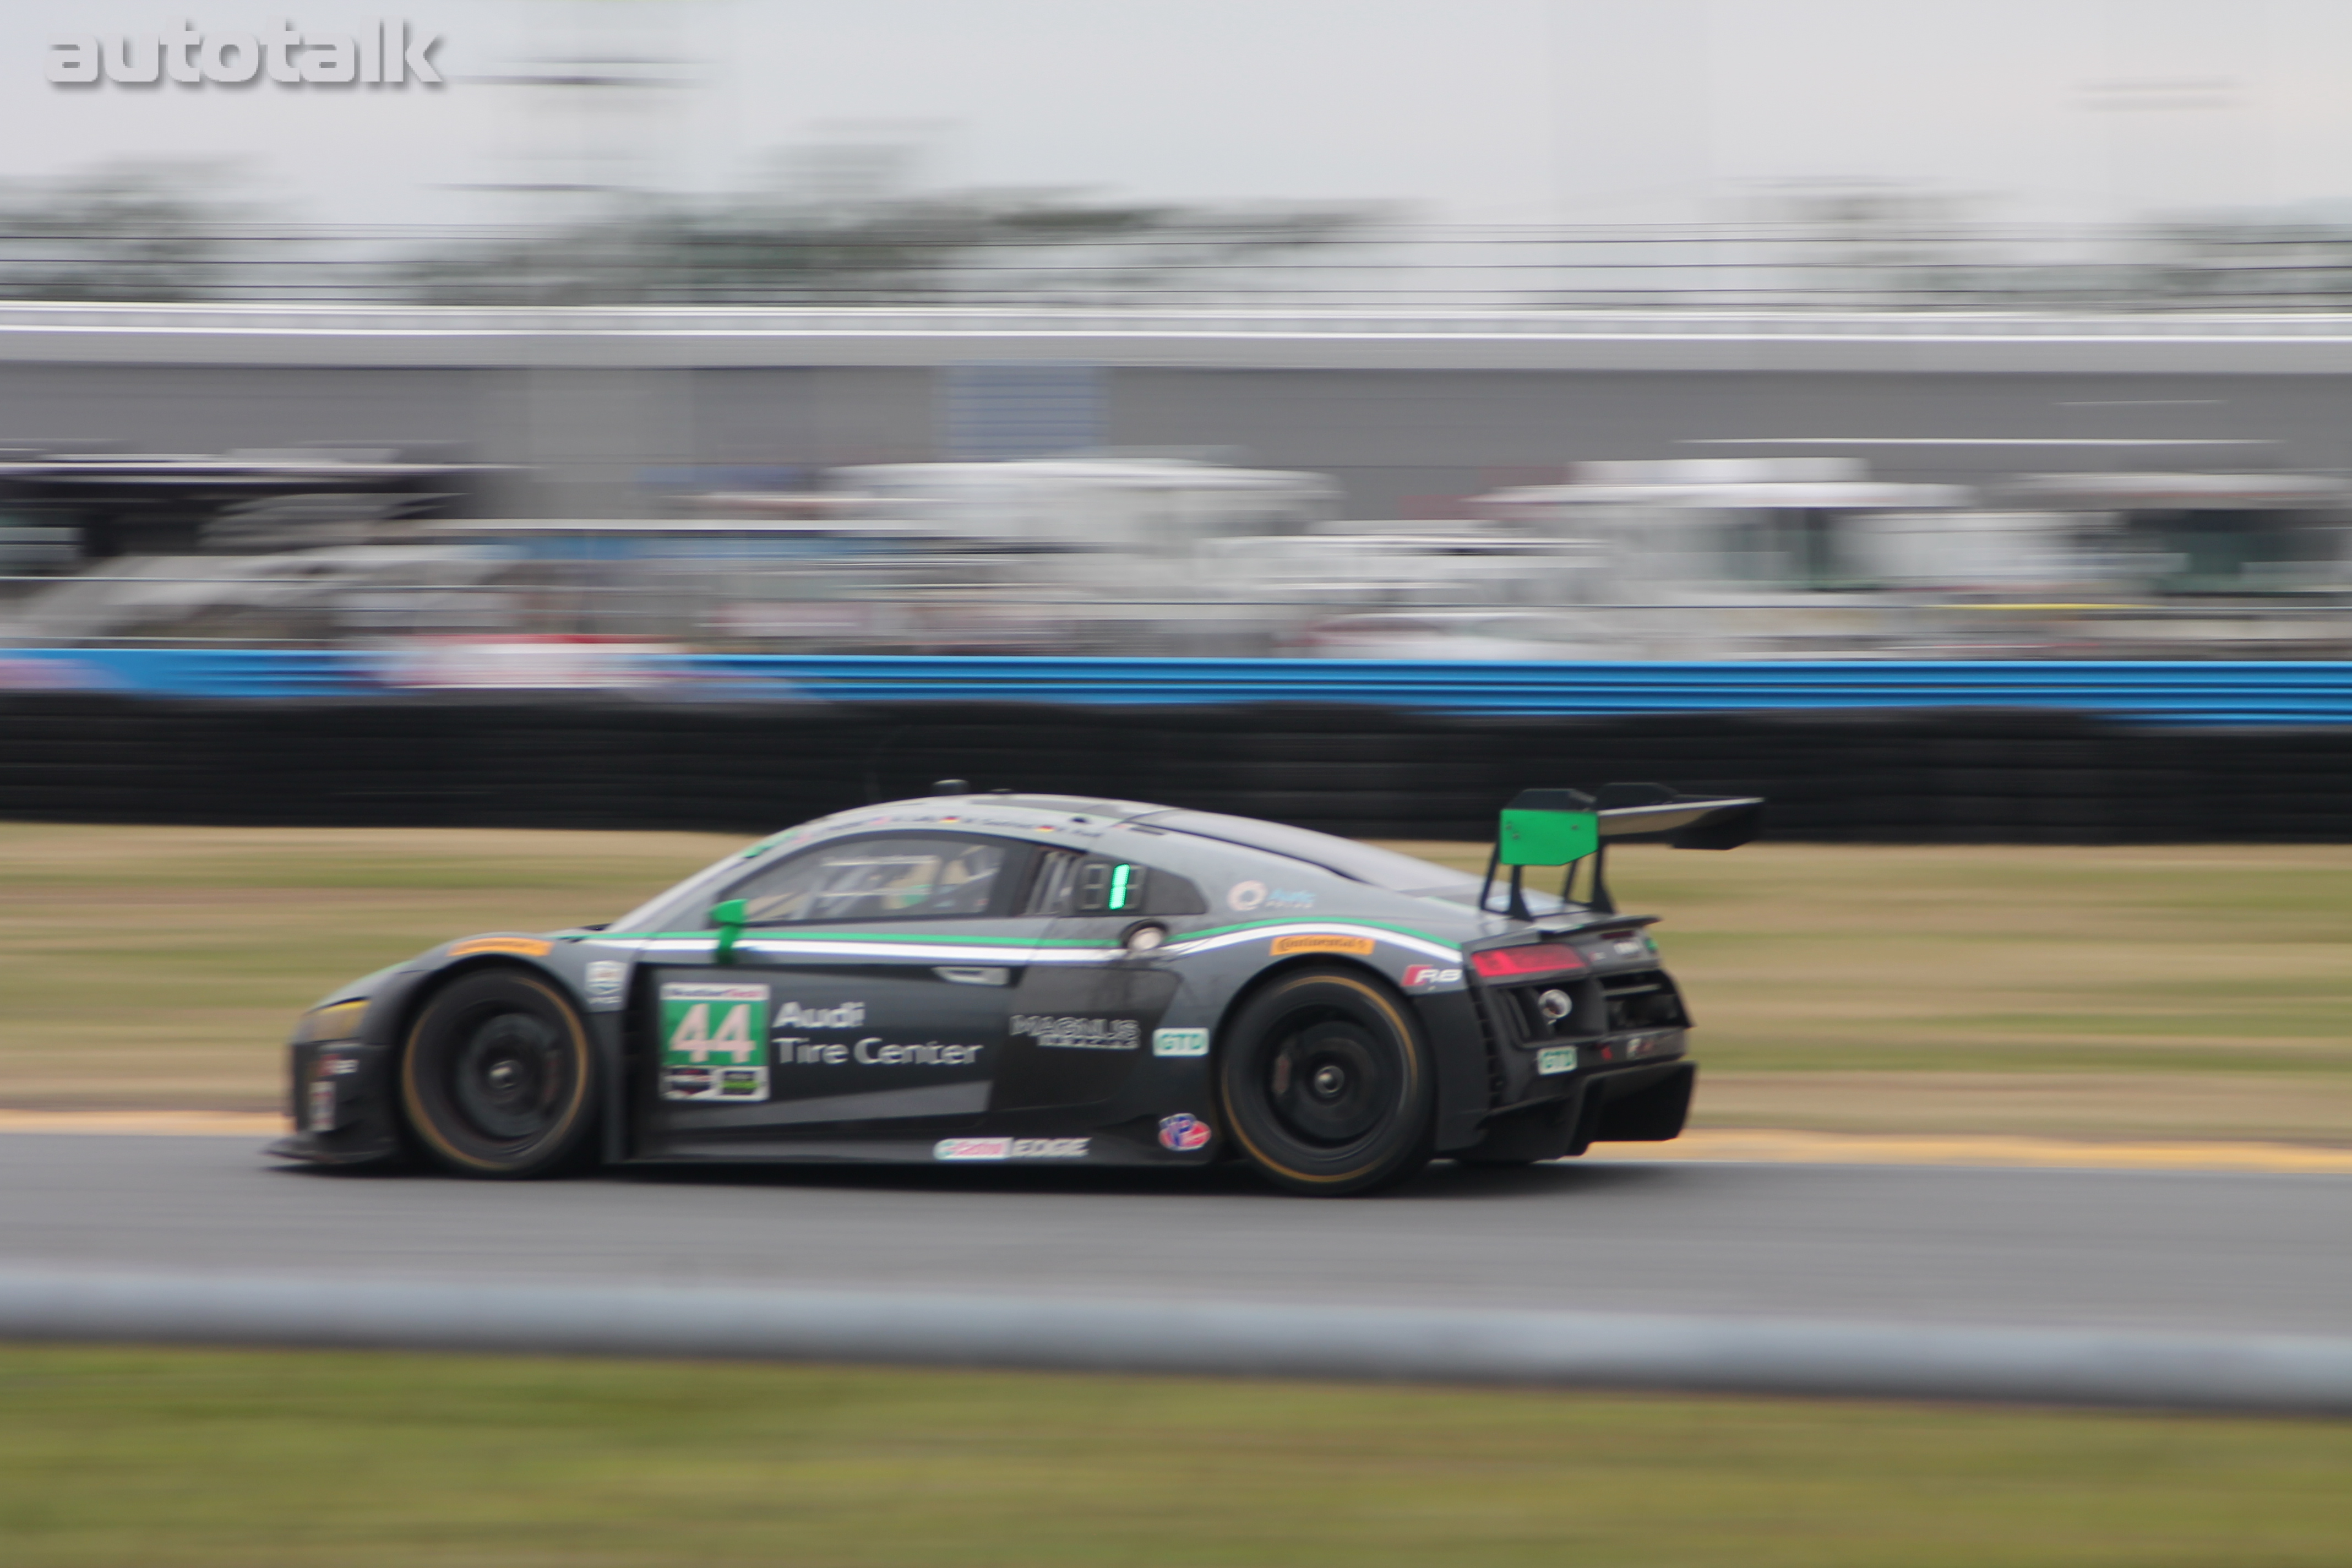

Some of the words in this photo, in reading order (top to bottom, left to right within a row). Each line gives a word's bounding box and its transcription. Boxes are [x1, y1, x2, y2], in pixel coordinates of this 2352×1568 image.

[1413, 969, 1462, 983] R8
[772, 1001, 865, 1028] Audi
[667, 1003, 757, 1064] 44
[1160, 1032, 1204, 1051] GTD
[771, 1037, 850, 1064] Tire
[853, 1037, 984, 1065] Center
[1012, 1137, 1092, 1157] EDGE
